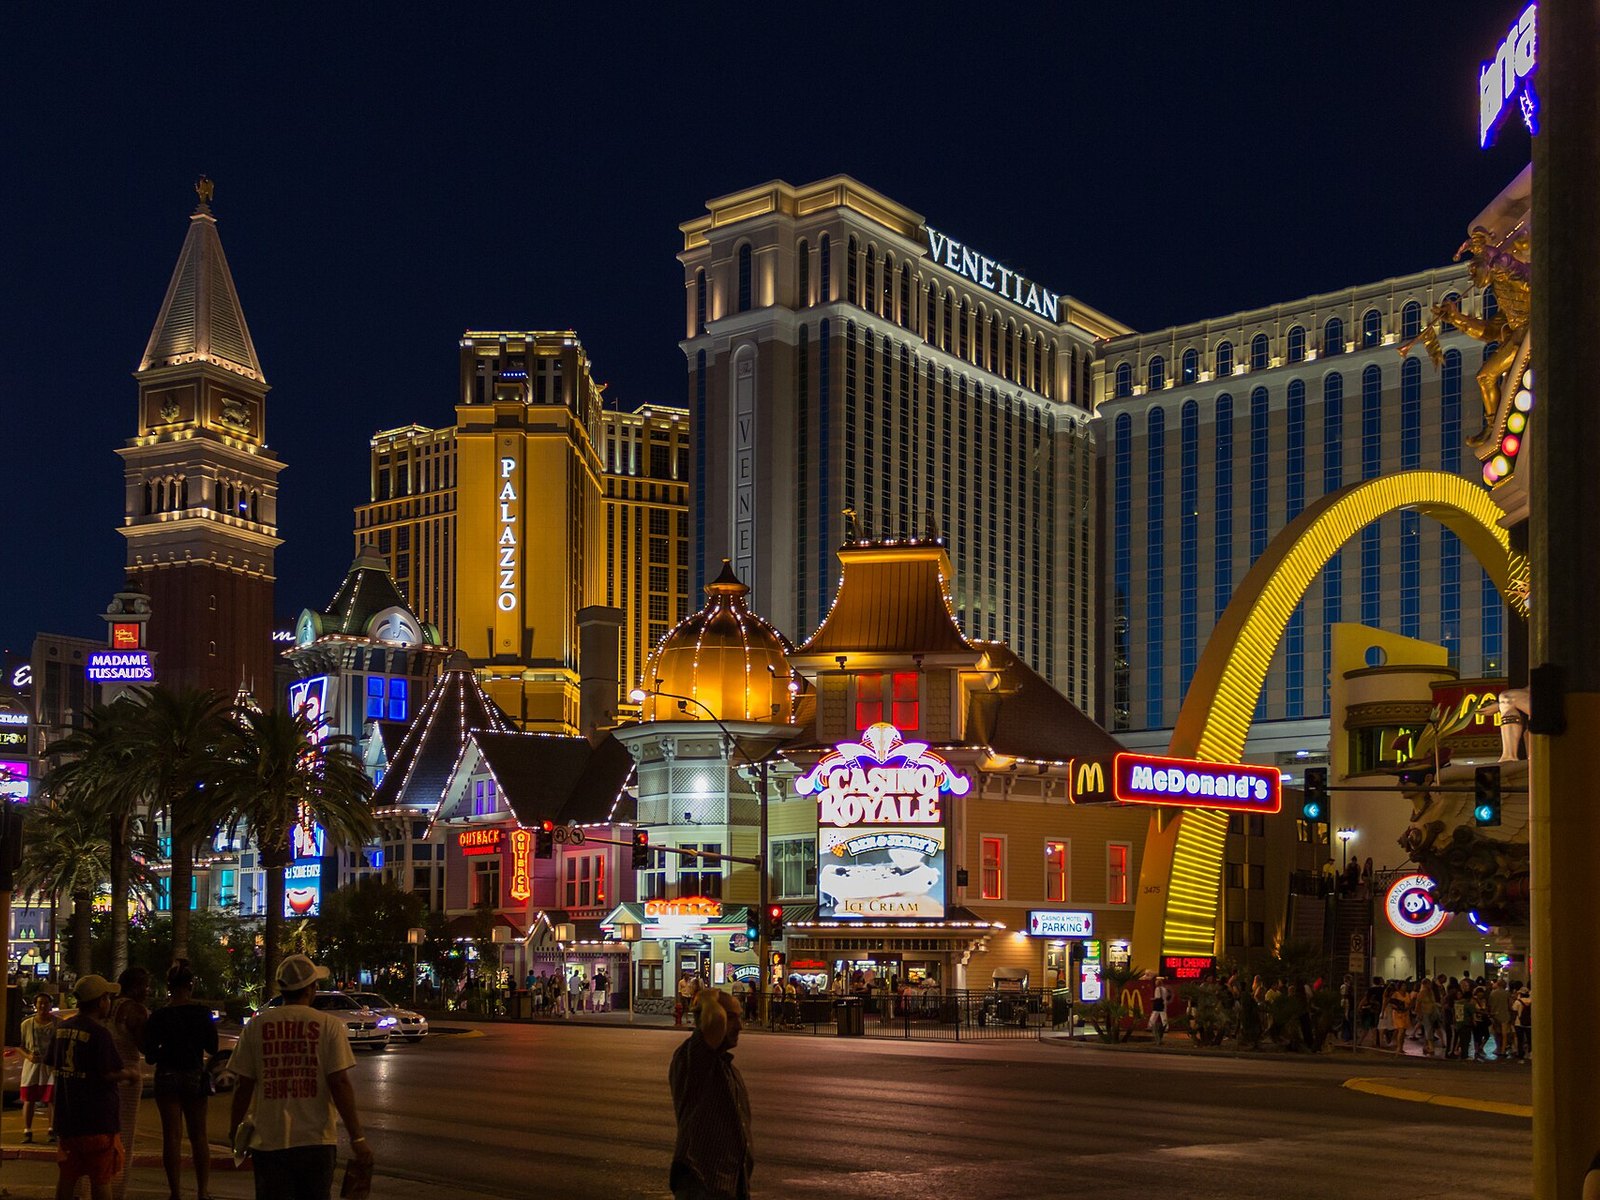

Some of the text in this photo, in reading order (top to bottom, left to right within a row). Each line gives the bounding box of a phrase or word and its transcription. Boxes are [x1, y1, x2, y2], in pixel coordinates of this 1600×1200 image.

[926, 226, 1059, 322] VENETIAN
[499, 458, 517, 611] PALAZZO
[92, 655, 148, 666] MADAME
[829, 767, 937, 796] CASINO
[1131, 766, 1268, 800] McDonald's
[817, 787, 940, 827] ROYALE
[460, 830, 499, 847] OUTBACK
[848, 836, 877, 853] BEN
[886, 834, 937, 853] JERRY'S
[517, 833, 525, 893] OUTBACK
[1390, 880, 1412, 905] PANDA
[646, 904, 719, 917] OUTBACK
[845, 899, 919, 912] ICE CREAM
[1042, 922, 1082, 932] PARKING
[1166, 957, 1211, 968] NEW CHERRY
[1176, 968, 1201, 978] BERRY
[262, 1021, 320, 1040] GIRLS
[262, 1041, 319, 1055] DIRECT
[262, 1056, 318, 1068] TO YOU IN
[278, 1068, 317, 1078] MINUTES
